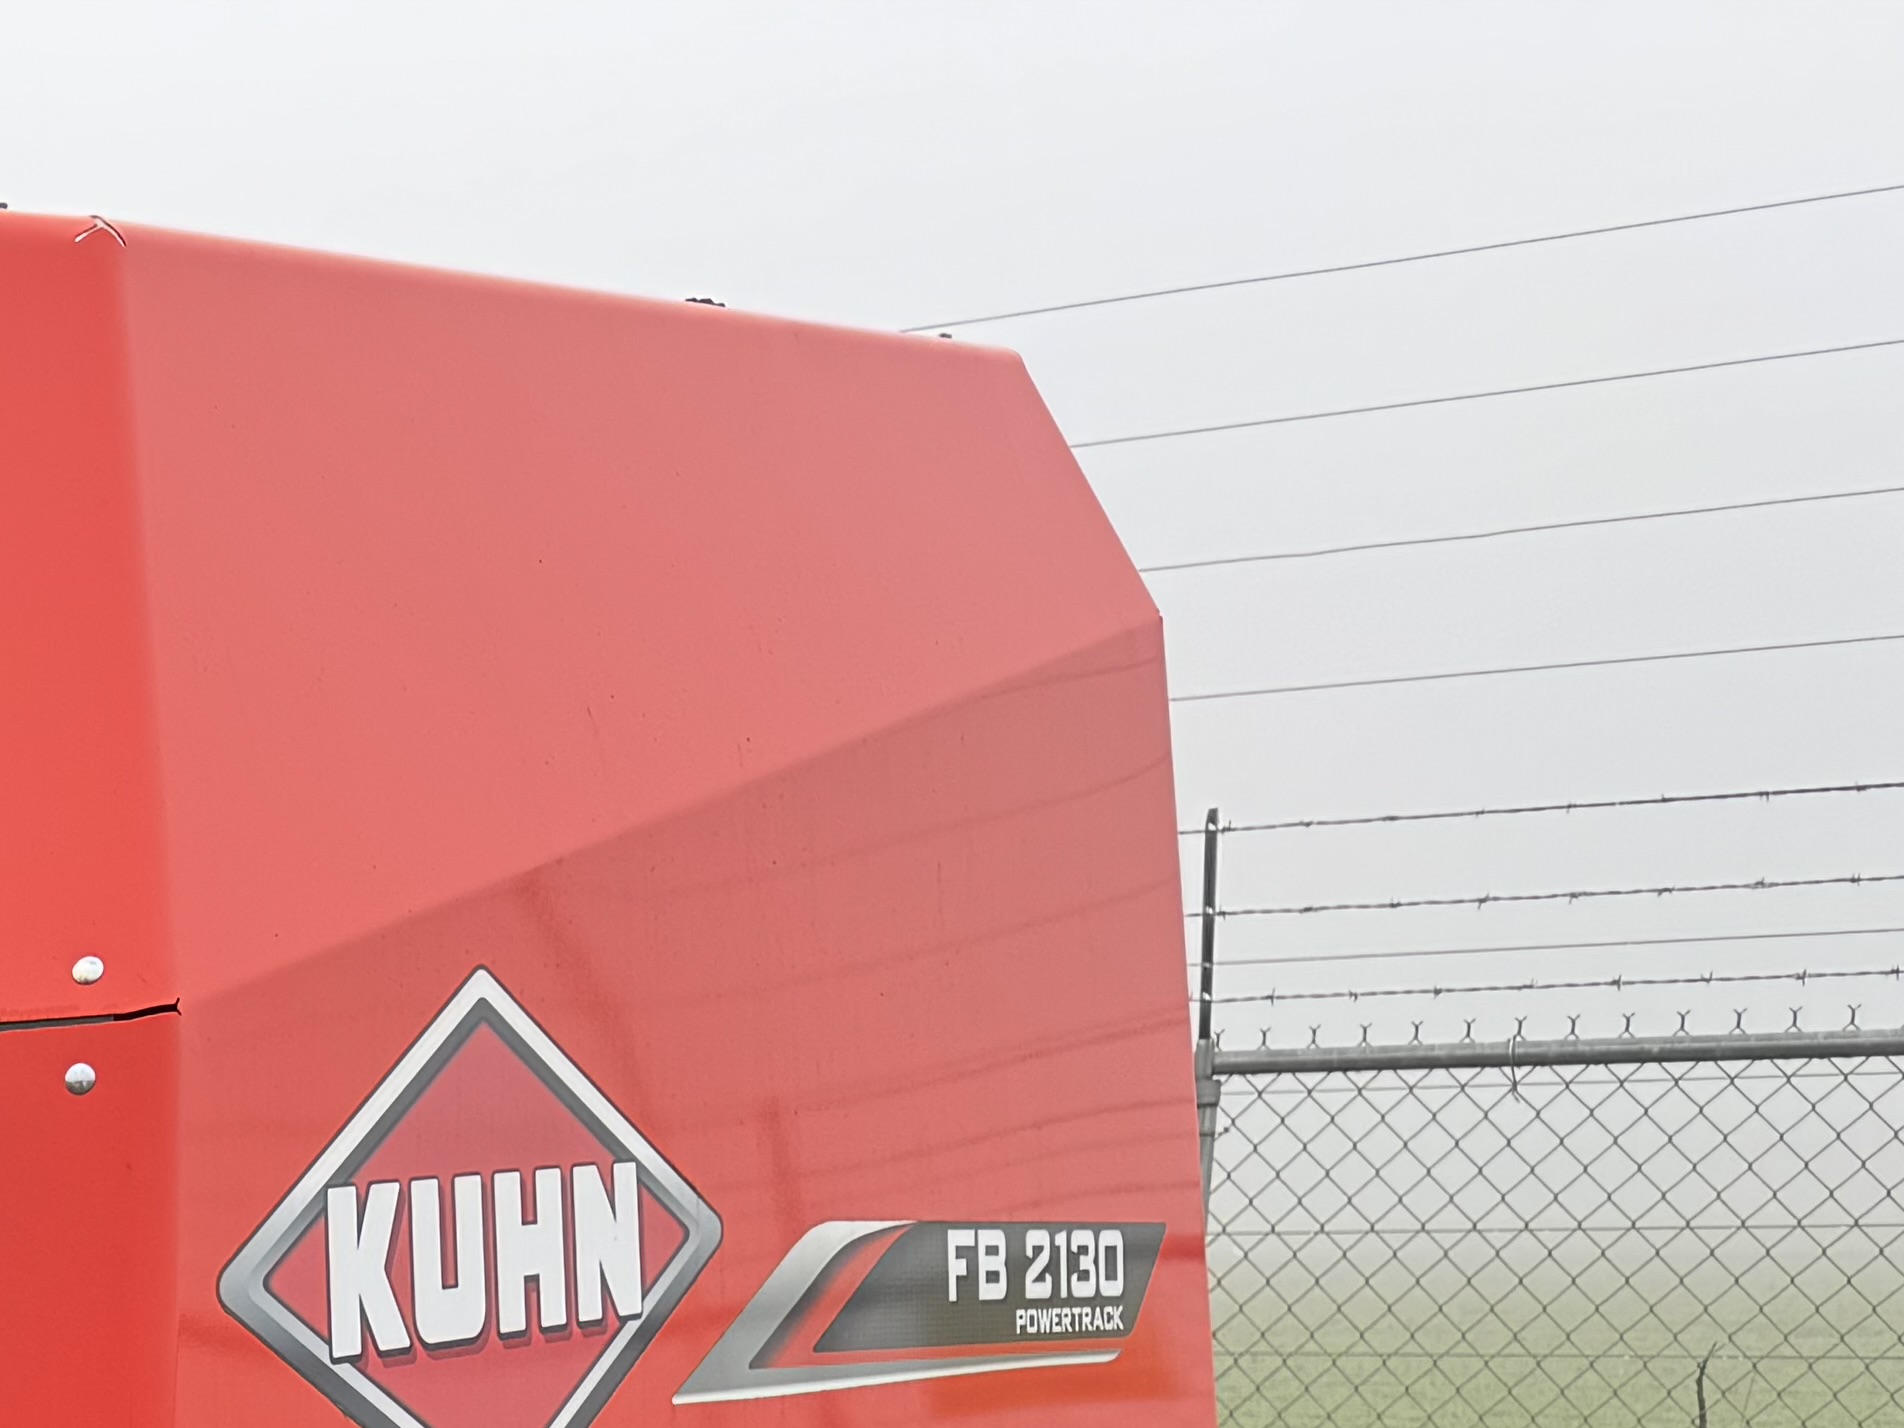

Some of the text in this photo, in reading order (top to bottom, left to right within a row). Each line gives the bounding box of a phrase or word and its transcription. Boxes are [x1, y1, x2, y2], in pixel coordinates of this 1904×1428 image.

[325, 1161, 643, 1362] KUHN
[947, 1228, 1124, 1302] FB 2130
[1016, 1305, 1124, 1334] POWERTRACK
